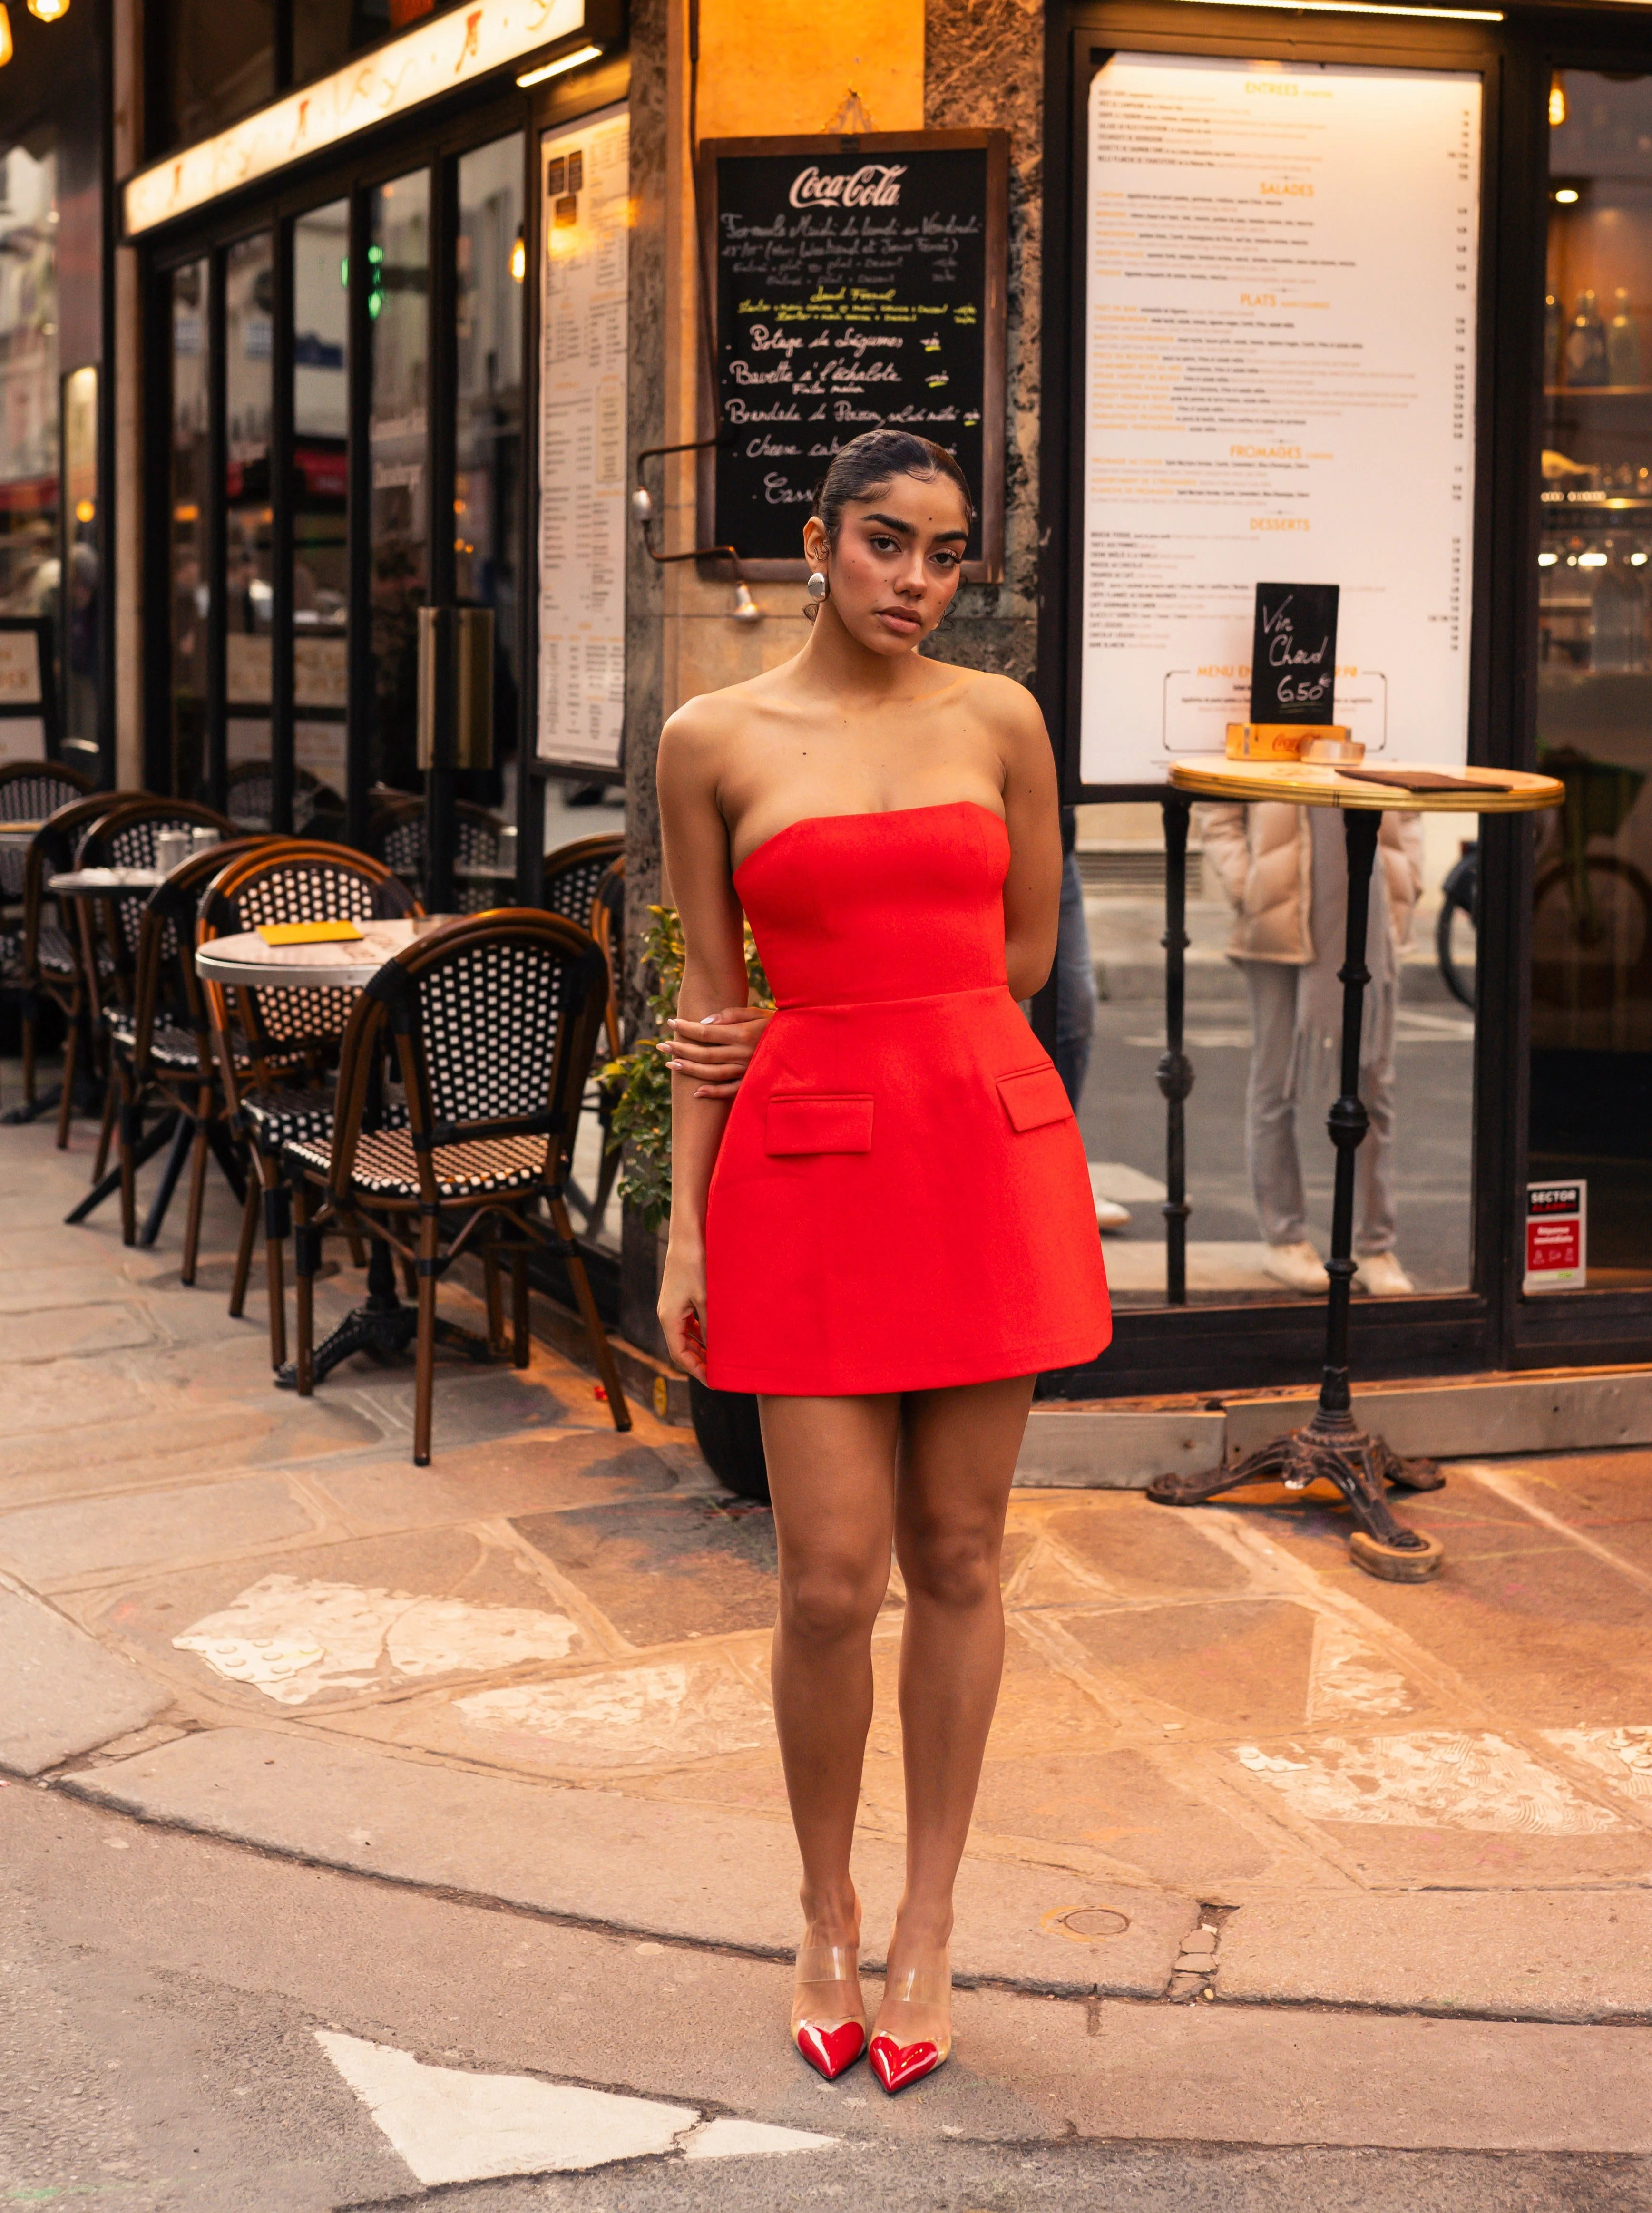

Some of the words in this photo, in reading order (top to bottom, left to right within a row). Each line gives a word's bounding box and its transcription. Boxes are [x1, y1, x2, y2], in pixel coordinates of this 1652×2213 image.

[1260, 182, 1315, 197] SALADES
[1241, 294, 1277, 308] PLATS
[749, 324, 805, 358] Potage
[1230, 445, 1302, 459] FROMAGES
[1250, 517, 1310, 532] DESSERTS
[1263, 594, 1294, 634] Vin
[1269, 634, 1329, 666] Chaud
[1197, 664, 1233, 678] MENU
[1531, 1189, 1577, 1204] SECTOR
